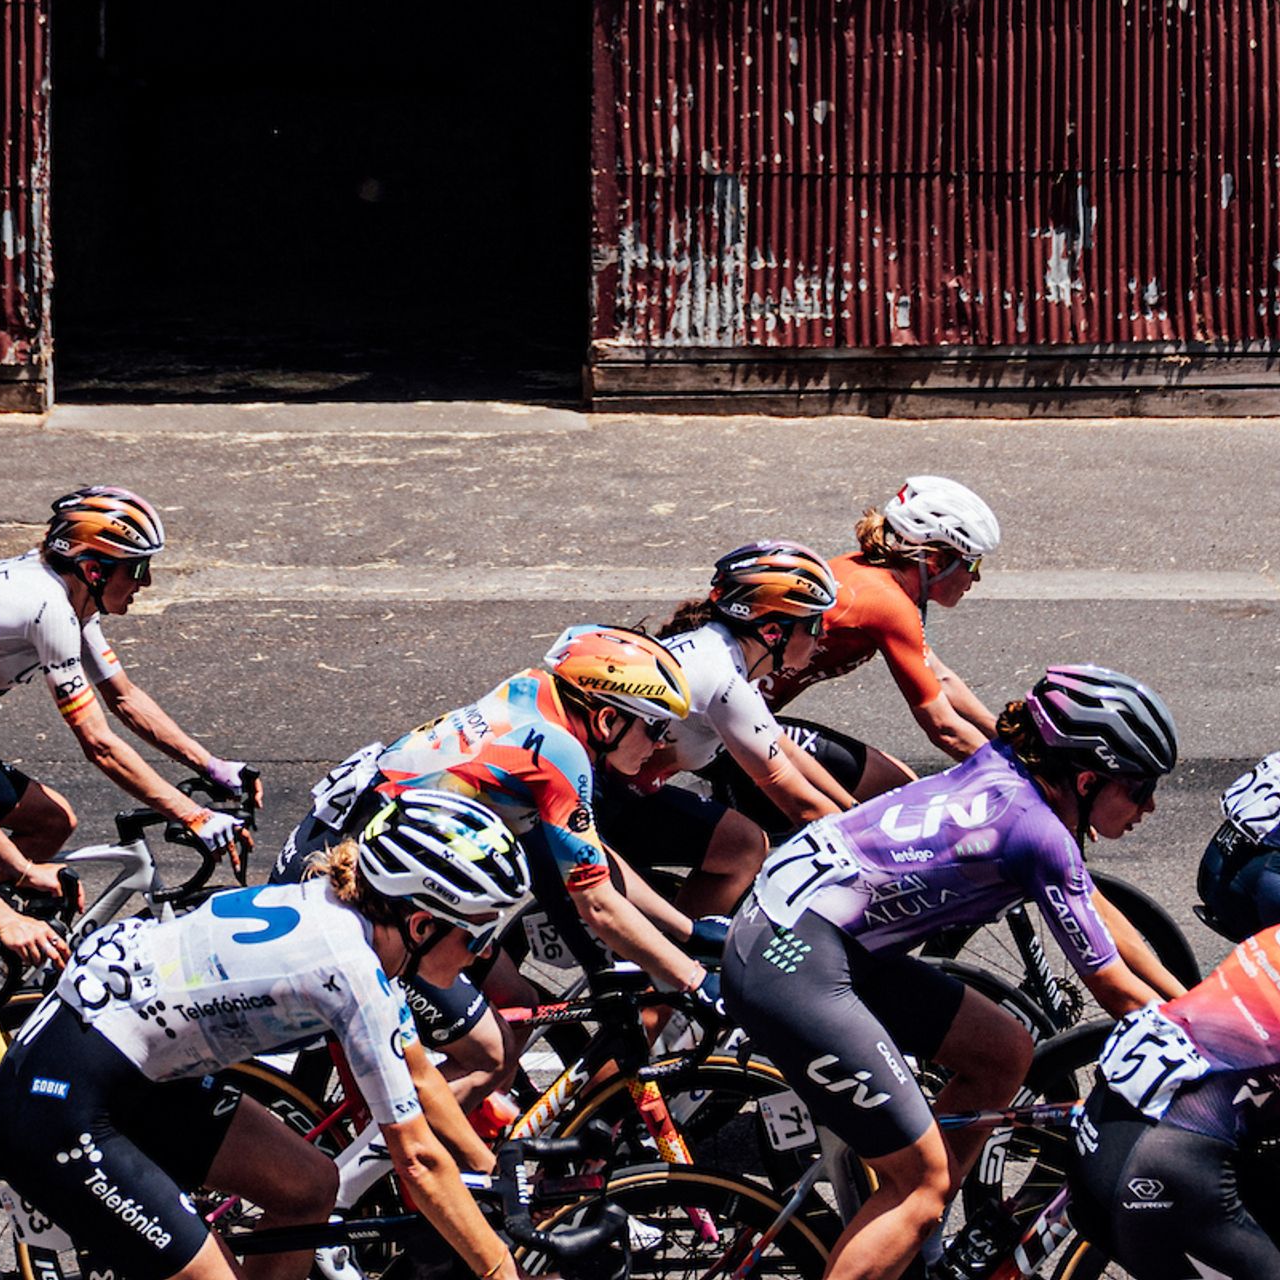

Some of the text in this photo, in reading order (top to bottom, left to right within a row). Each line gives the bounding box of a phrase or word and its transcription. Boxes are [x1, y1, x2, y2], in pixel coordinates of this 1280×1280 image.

[111, 519, 142, 542] MET
[577, 675, 668, 697] SPECIALIZED
[1094, 744, 1120, 771] Liv
[880, 790, 989, 842] Liv
[766, 833, 833, 908] 71
[425, 879, 458, 903] ABUS
[1044, 884, 1098, 960] CADEX
[536, 923, 563, 961] 126
[1029, 935, 1064, 1012] CANYON
[173, 990, 276, 1022] Telefónica
[876, 1040, 908, 1085] CADEX
[32, 1078, 67, 1097] GOBIK
[807, 1054, 892, 1109] Liv
[779, 1105, 807, 1140] 71
[84, 1167, 173, 1250] Telefónica
[1122, 1200, 1174, 1210] VERGE
